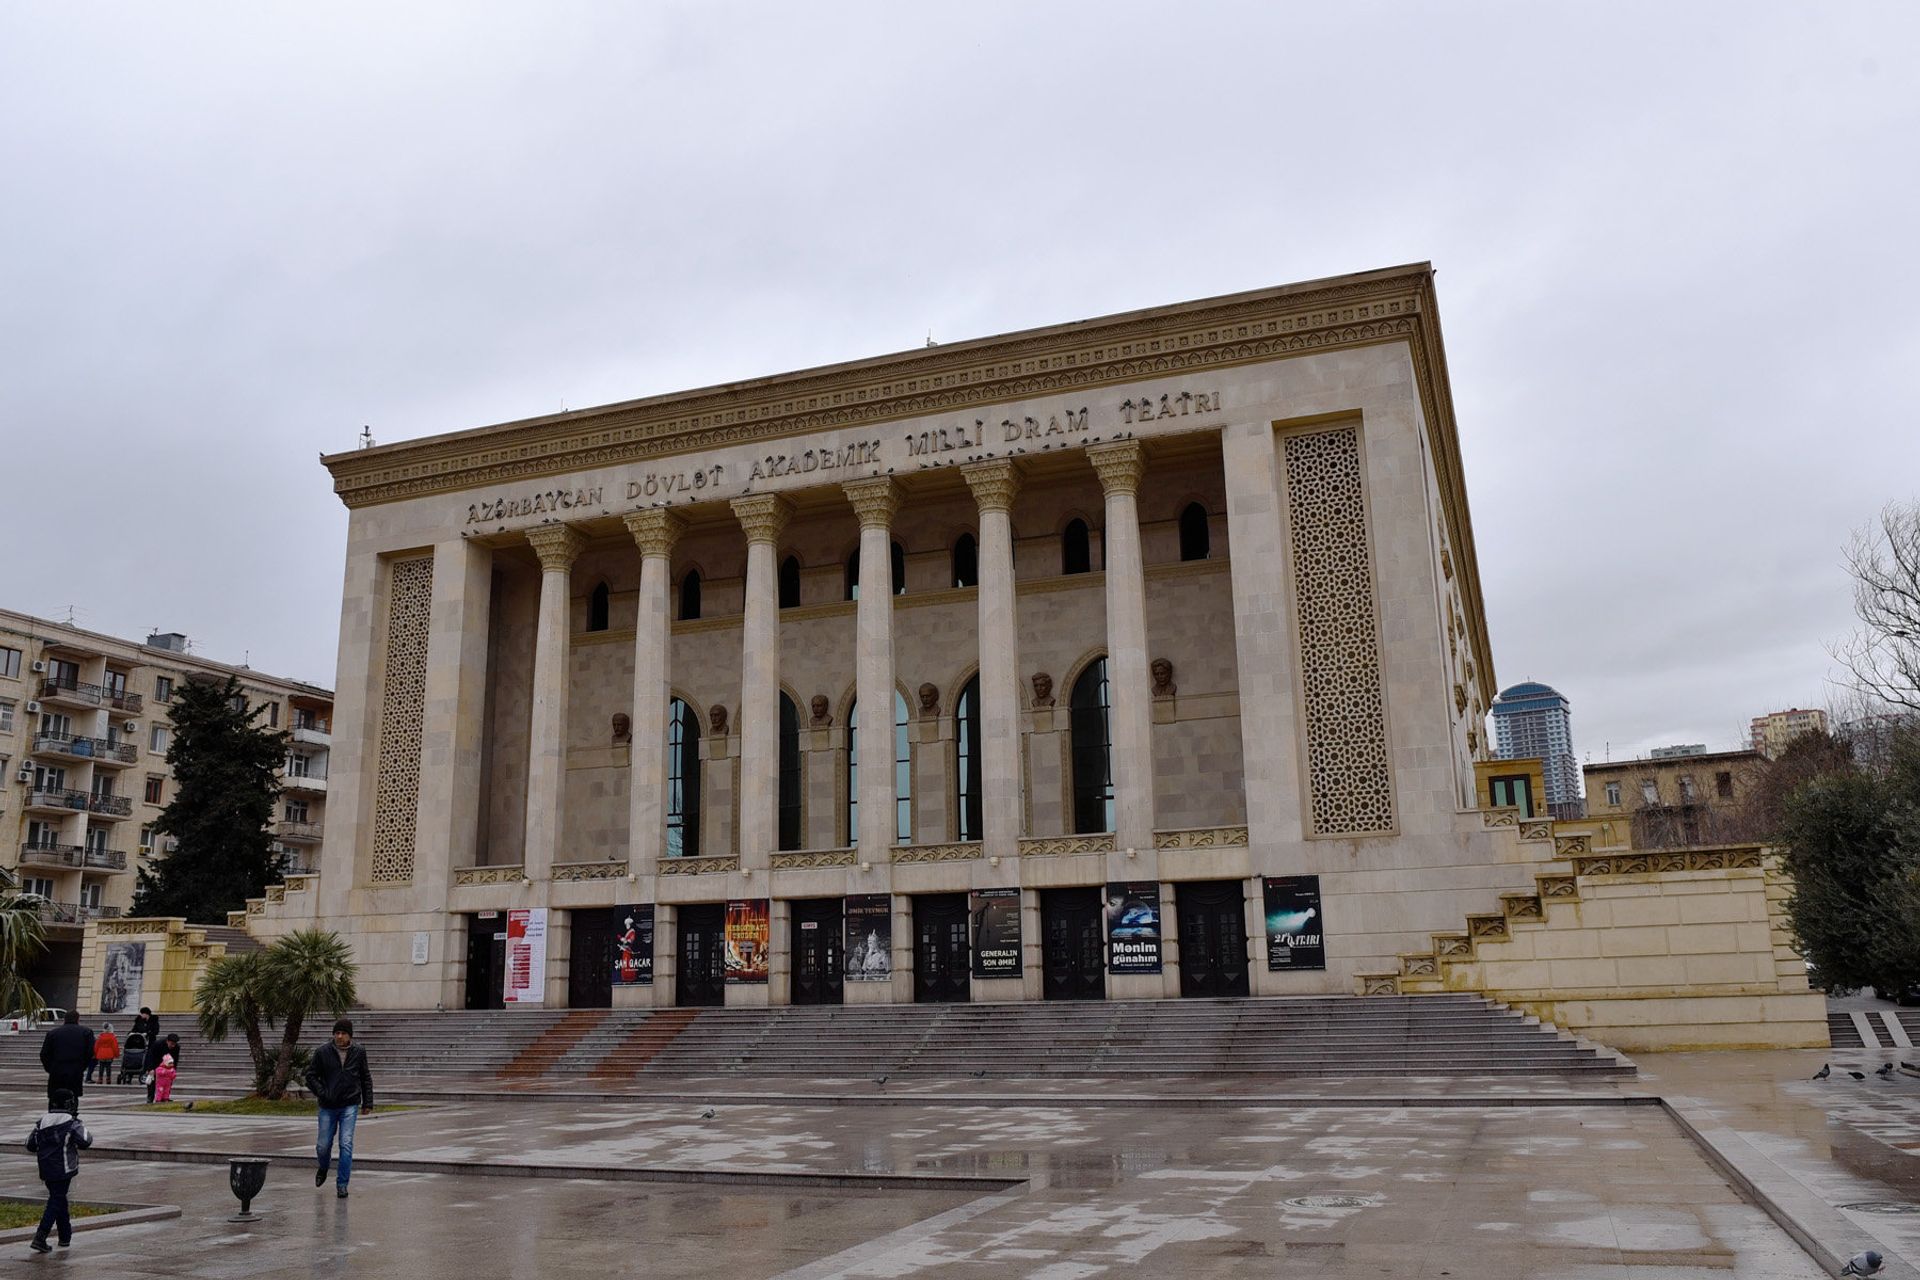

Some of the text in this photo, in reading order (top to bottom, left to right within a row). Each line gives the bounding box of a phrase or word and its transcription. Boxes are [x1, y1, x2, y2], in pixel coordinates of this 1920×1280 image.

[1002, 408, 1088, 441] DRAM
[1112, 941, 1157, 953] Mənim
[980, 949, 1018, 957] GENERALIN
[982, 958, 997, 966] SON
[1112, 954, 1158, 965] günahım
